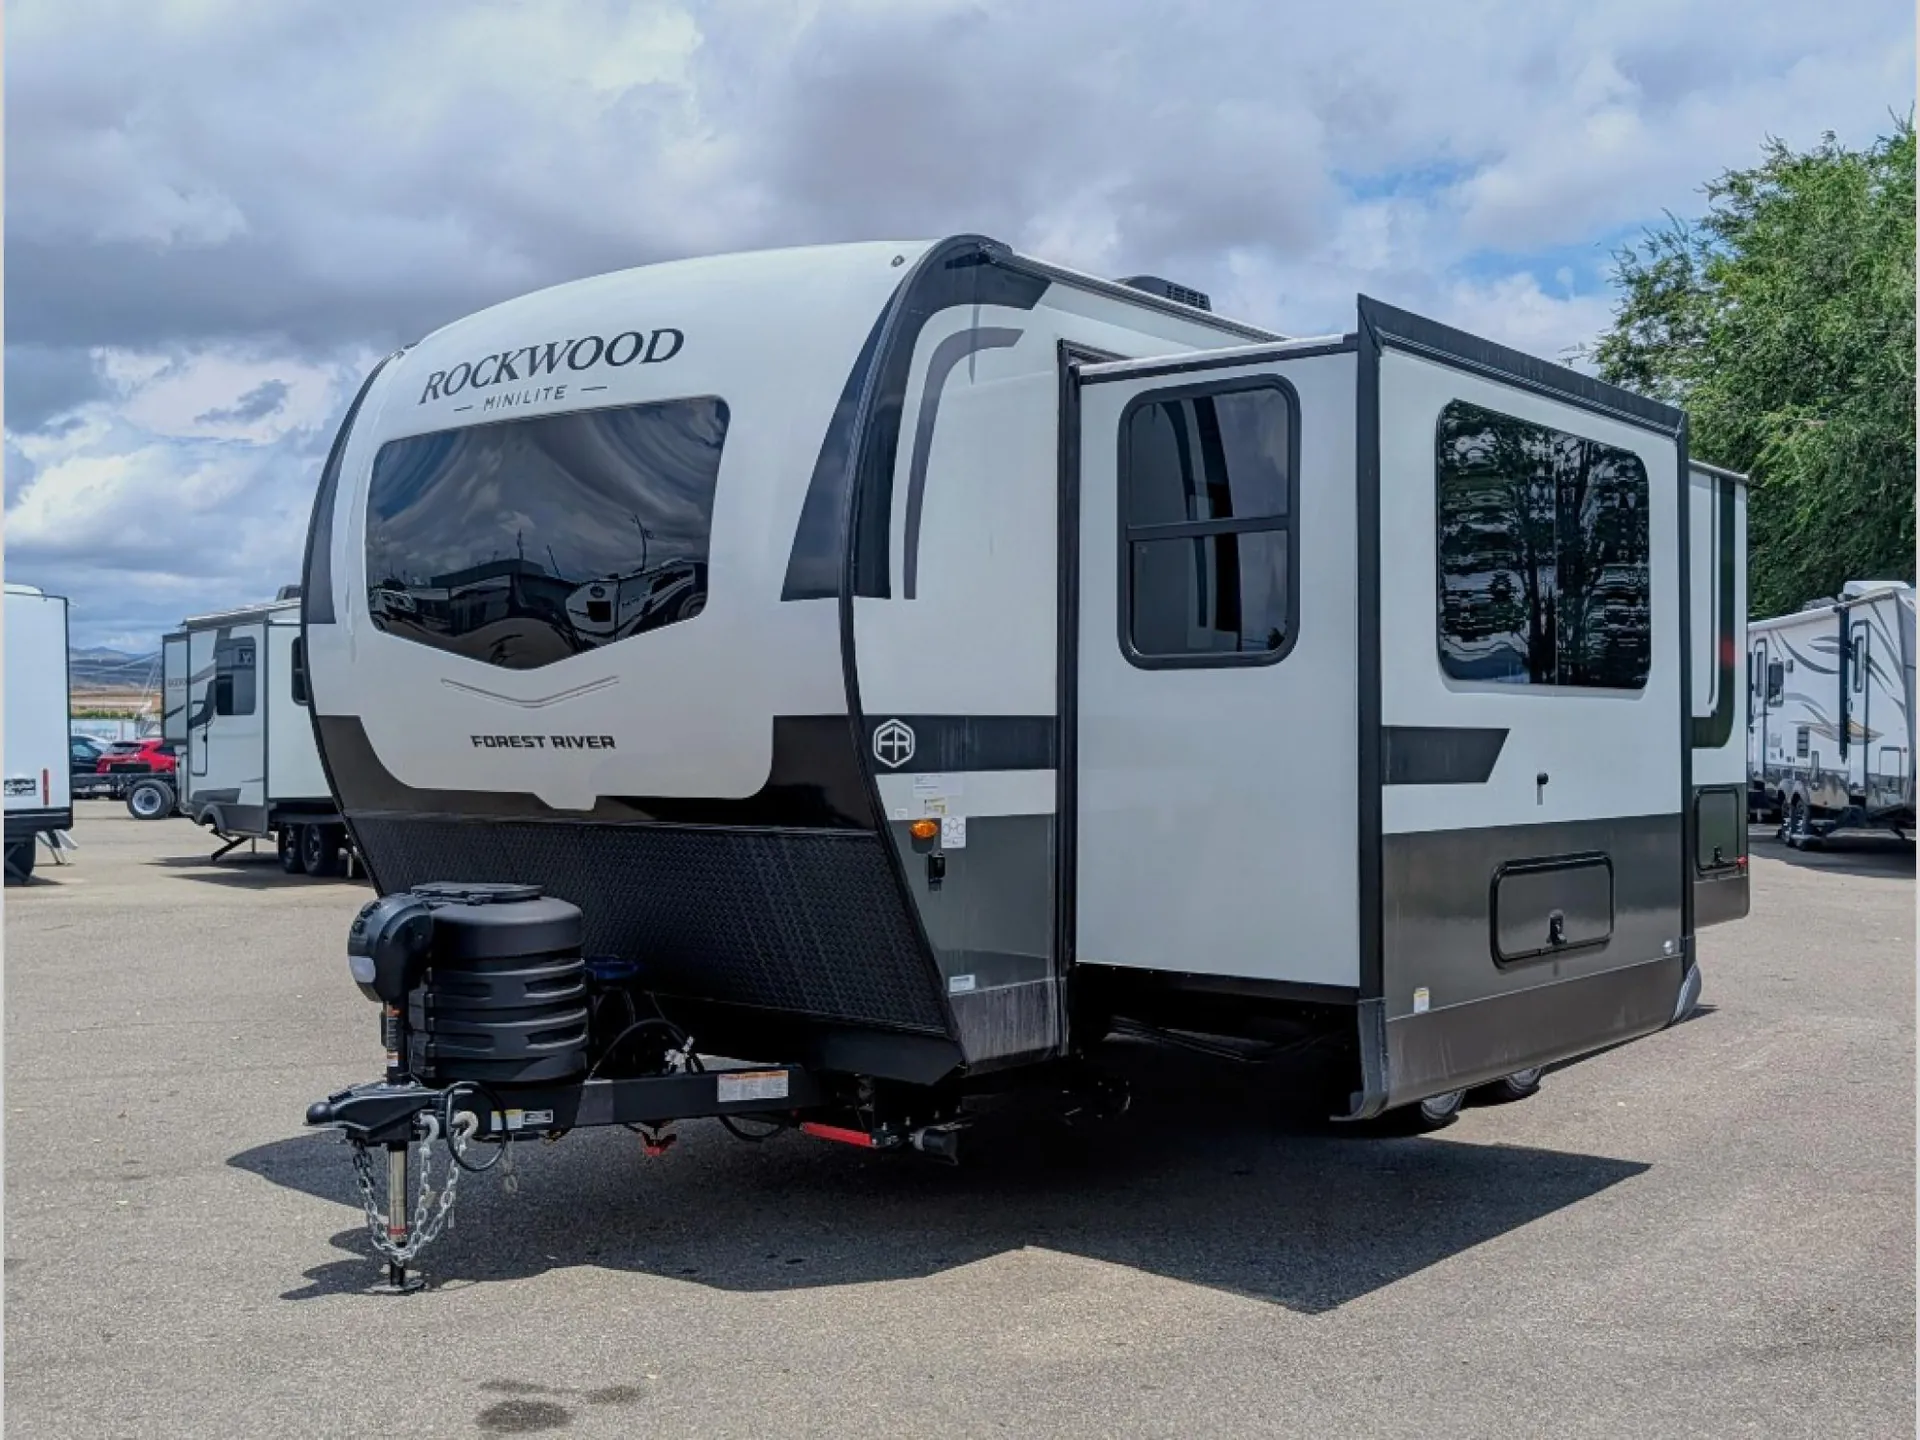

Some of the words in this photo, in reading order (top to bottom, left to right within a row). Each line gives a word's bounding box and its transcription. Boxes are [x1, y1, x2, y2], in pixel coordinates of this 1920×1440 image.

[418, 328, 685, 405] ROCKWOOD
[483, 385, 568, 411] MINILITE
[470, 735, 546, 748] FOREST
[549, 735, 616, 749] RIVER
